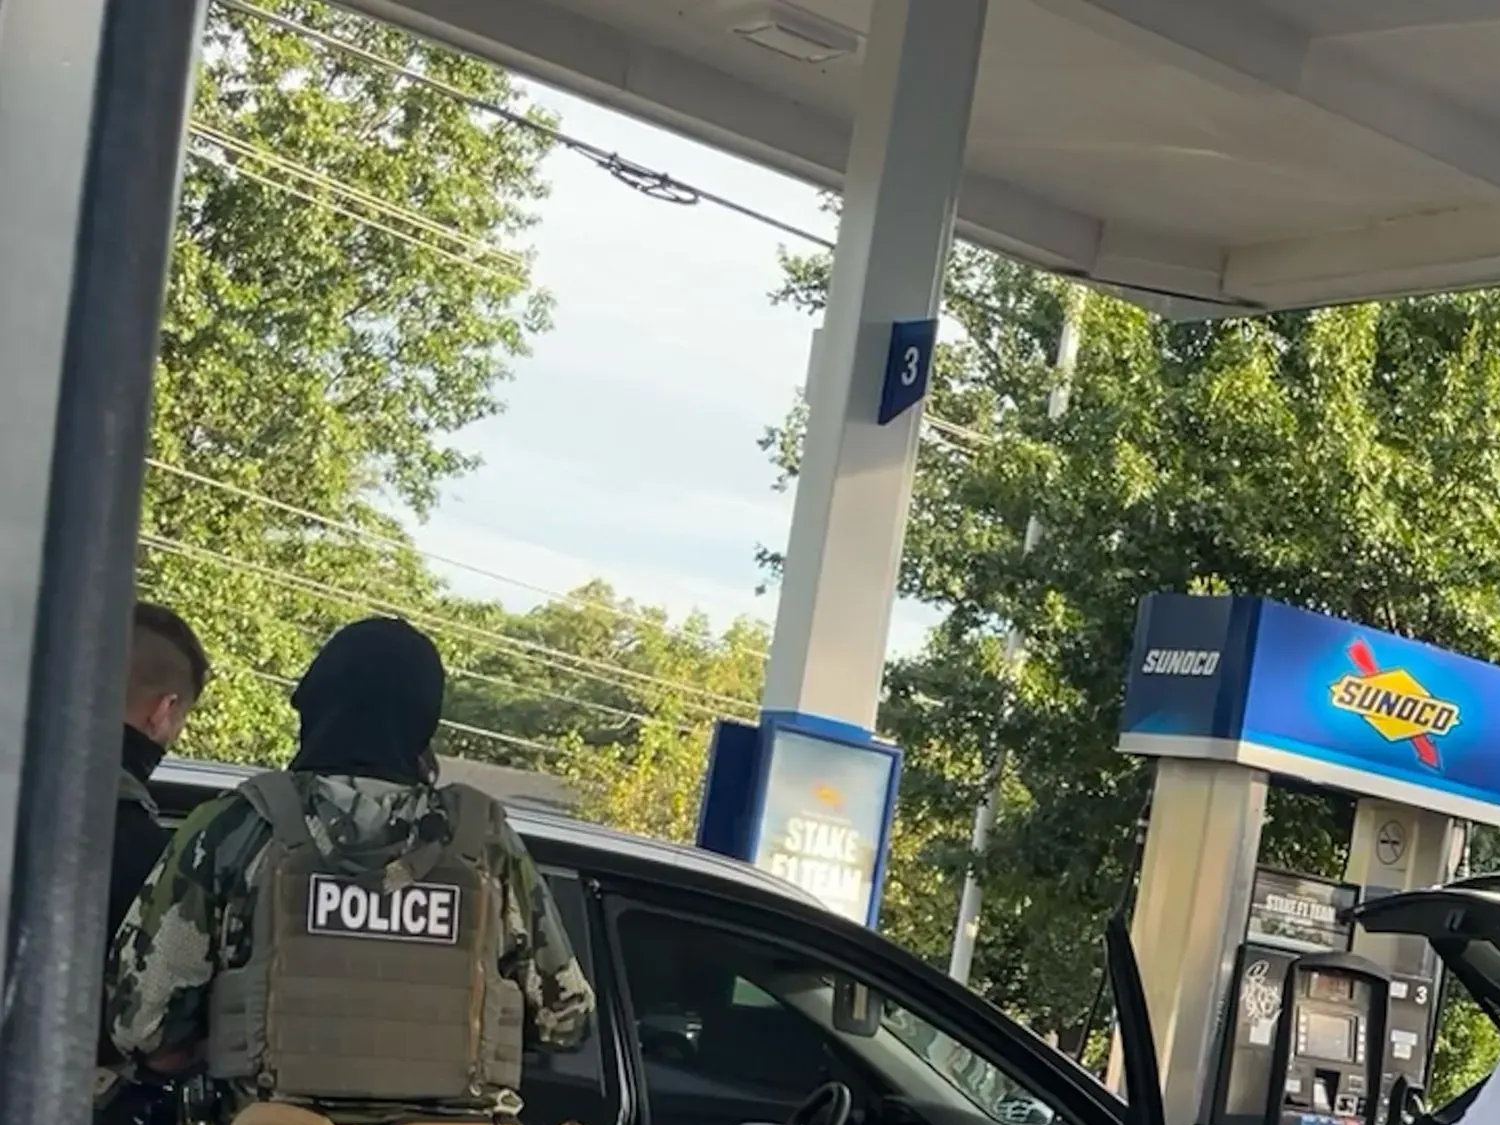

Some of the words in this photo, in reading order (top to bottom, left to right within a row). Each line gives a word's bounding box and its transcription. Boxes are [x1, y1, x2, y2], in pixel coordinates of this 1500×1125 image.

[901, 346, 919, 386] 3
[1141, 649, 1221, 676] SUNOCO
[1336, 680, 1456, 731] SUNOCO
[784, 816, 860, 863] STAKE
[316, 881, 451, 936] POLICE
[1415, 986, 1429, 1005] 3
